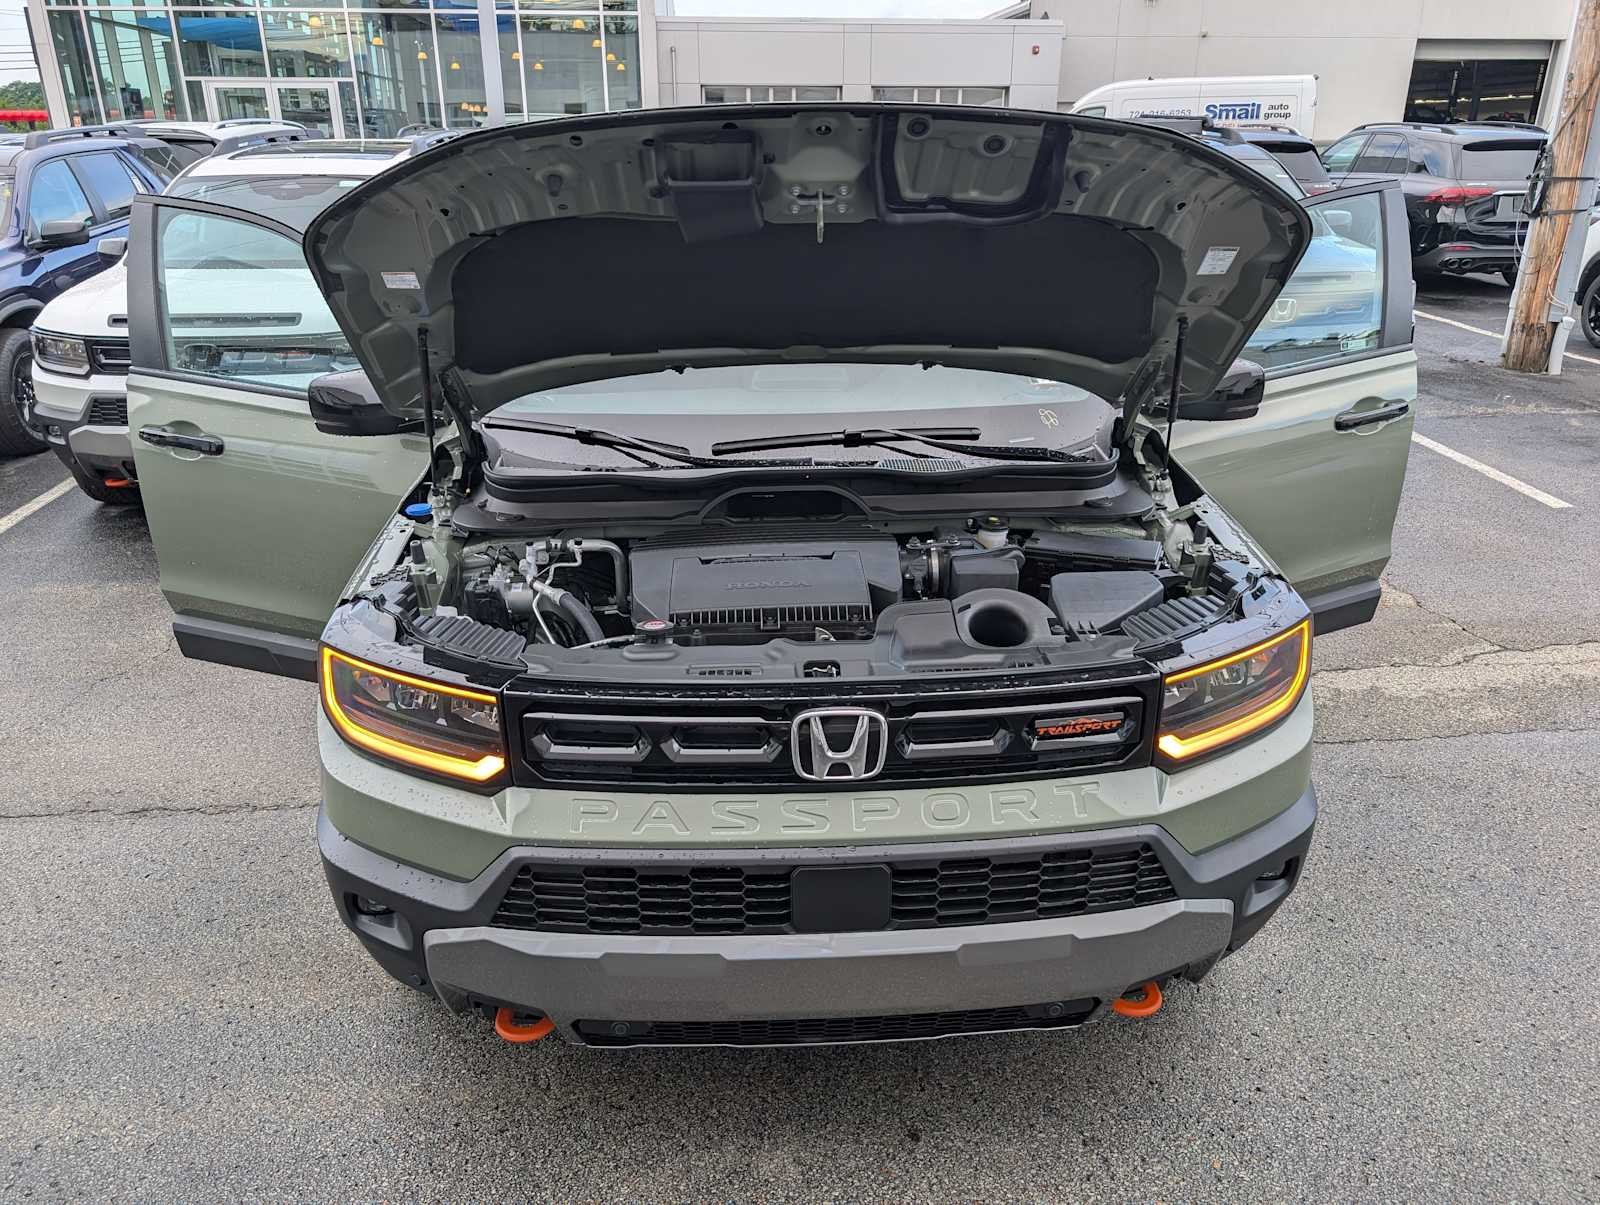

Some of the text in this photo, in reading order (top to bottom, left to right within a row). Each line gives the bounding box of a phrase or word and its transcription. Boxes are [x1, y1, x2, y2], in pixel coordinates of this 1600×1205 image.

[1129, 109, 1192, 119] 724216-6253
[1205, 102, 1261, 120] Smail
[1263, 112, 1292, 120] group
[725, 579, 812, 590] HONDA
[1037, 720, 1121, 735] TRAILSPORT
[568, 781, 1101, 835] PASSPORT
